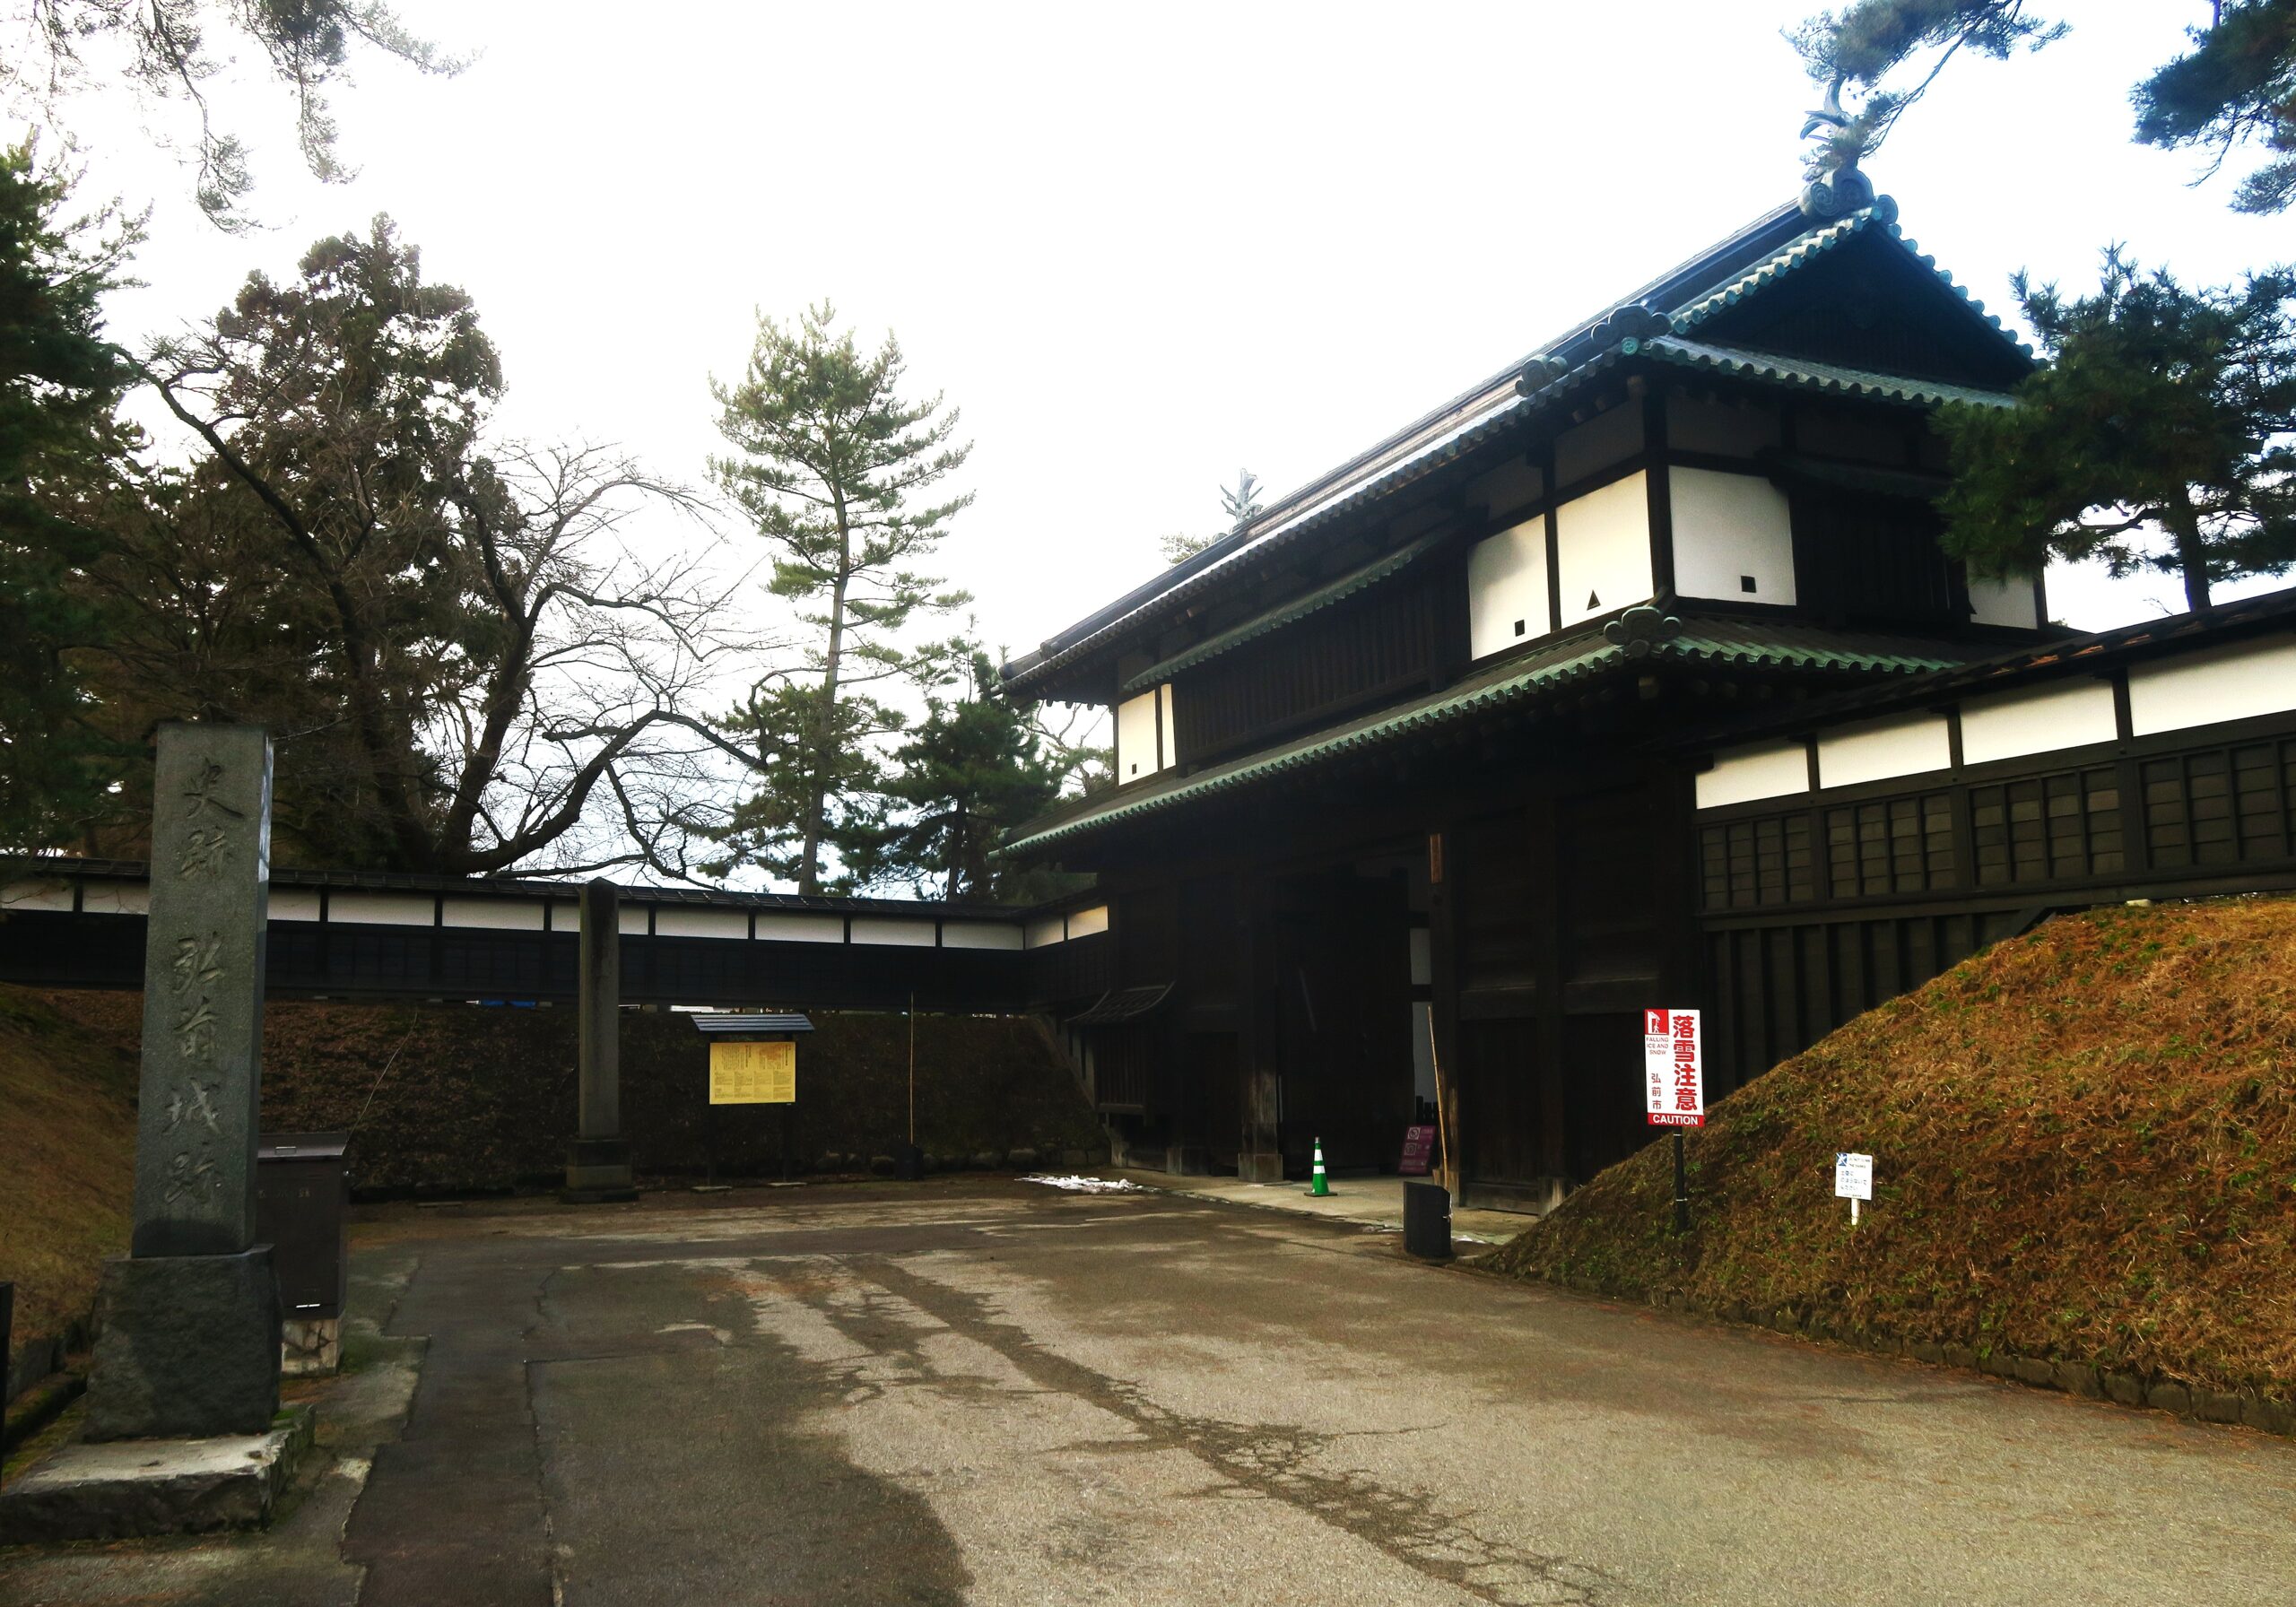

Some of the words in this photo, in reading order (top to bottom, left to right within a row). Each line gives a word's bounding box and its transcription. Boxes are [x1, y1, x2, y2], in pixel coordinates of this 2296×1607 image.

[1673, 1015, 1697, 1110] 落雪注意
[1651, 1073, 1662, 1110] 弘前市
[1652, 1114, 1699, 1125] CAUTION
